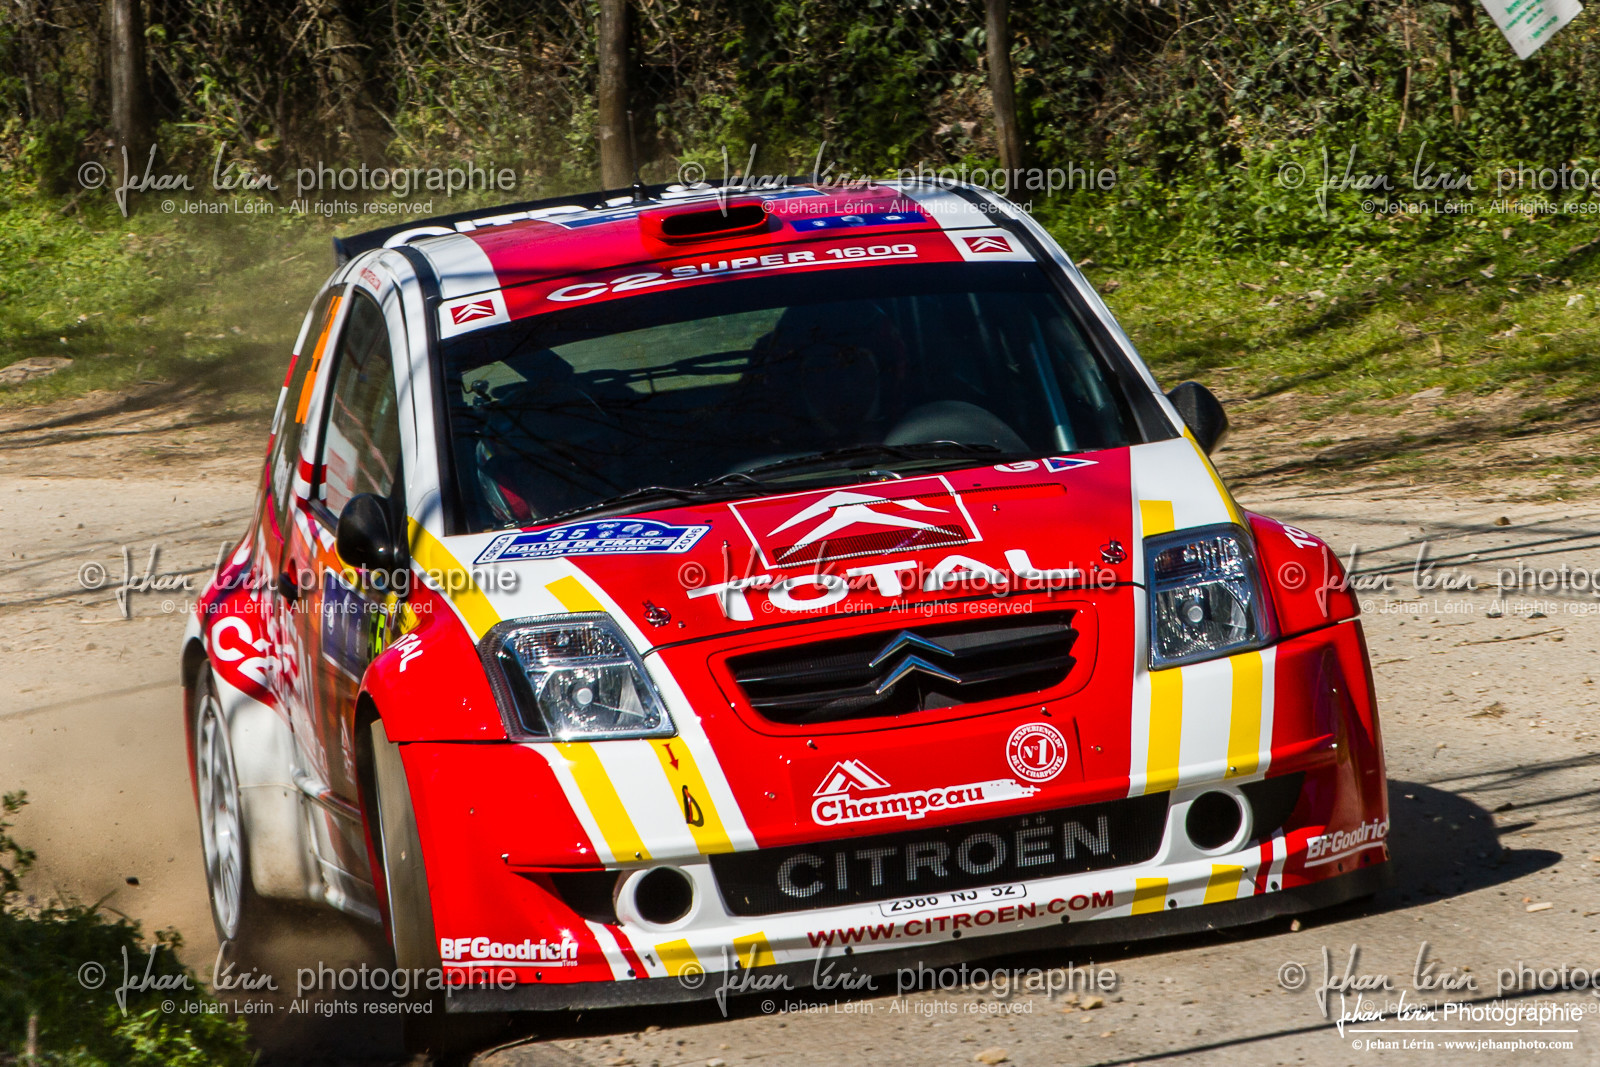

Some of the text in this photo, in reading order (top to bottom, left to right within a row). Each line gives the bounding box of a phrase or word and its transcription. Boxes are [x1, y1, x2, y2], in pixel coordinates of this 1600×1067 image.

[546, 243, 917, 302] C2 SUPER 1600
[504, 538, 673, 554] RALLYE DE FRANCE
[545, 528, 590, 541] 55
[674, 527, 703, 550] 2006
[521, 549, 564, 557] TOUR
[686, 549, 1081, 621] TOTAL
[1025, 755, 1064, 778] CHARPENTE
[816, 786, 985, 821] Champeau
[776, 814, 1110, 898] CITROËN
[807, 890, 1115, 948] WWW.CITROEN.COM
[441, 936, 578, 960] BFGoodrich
